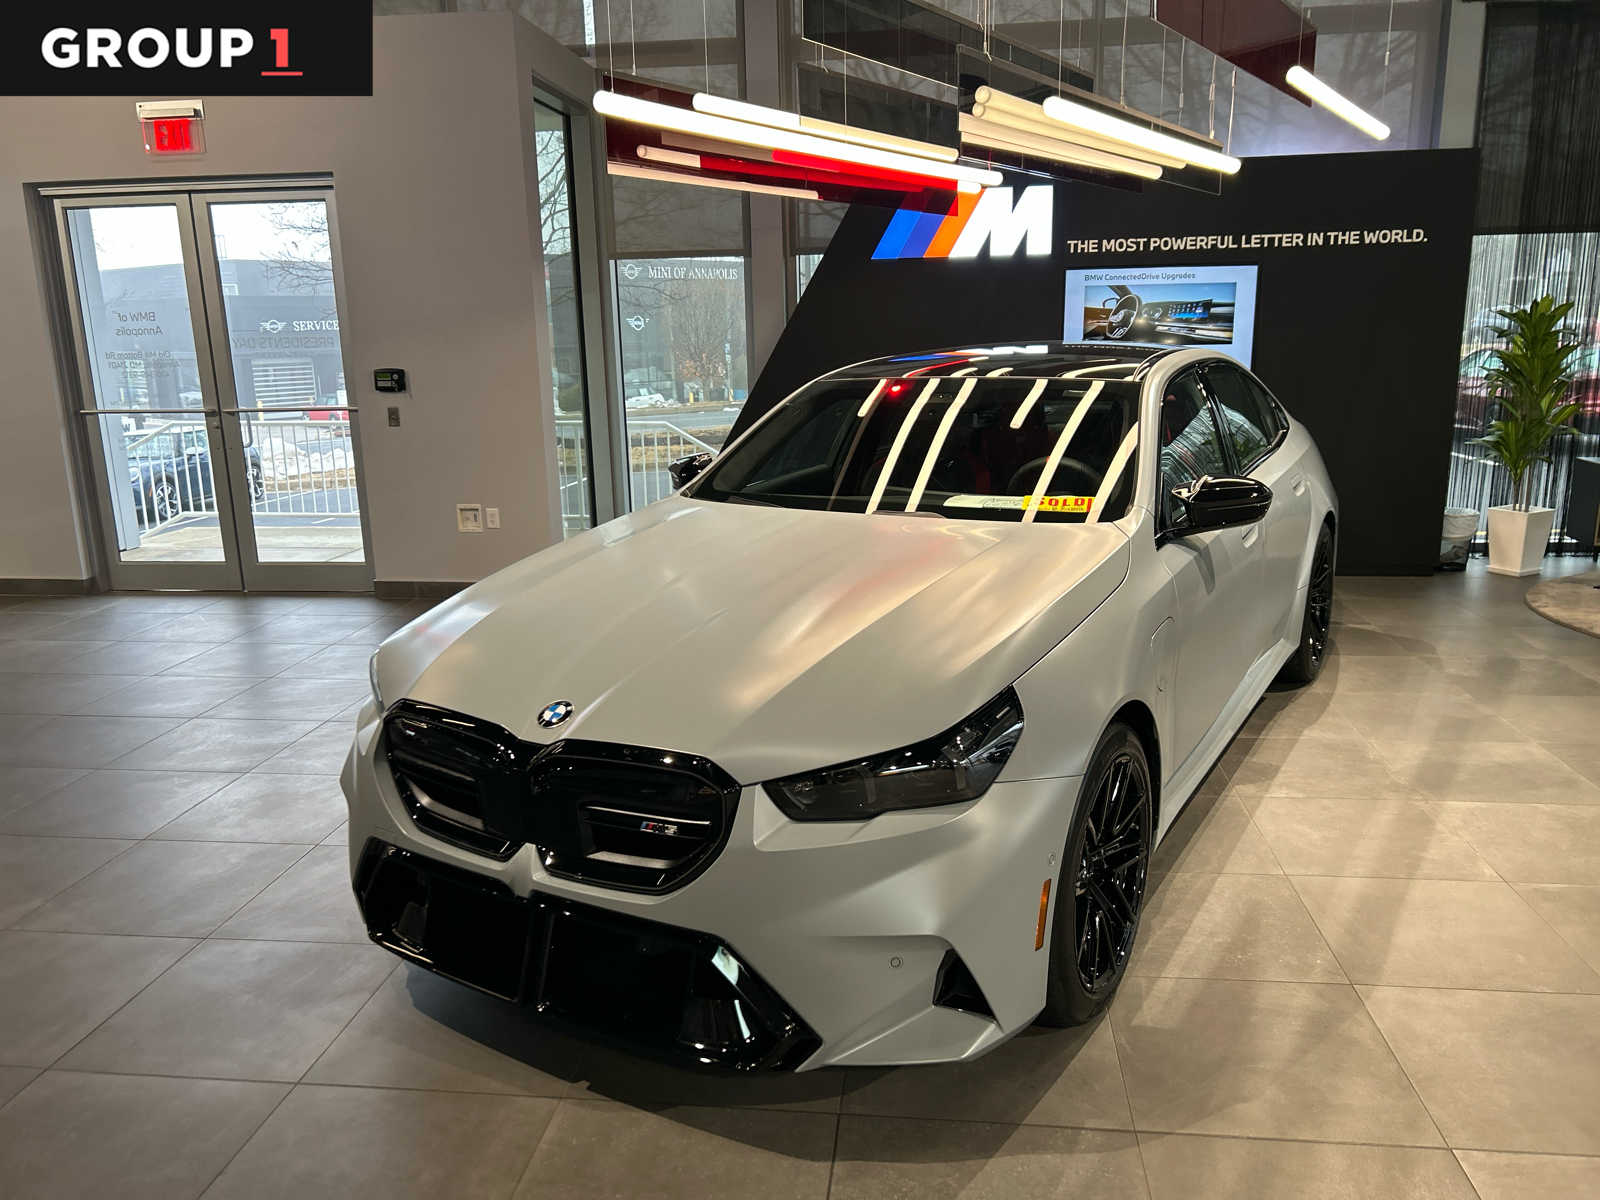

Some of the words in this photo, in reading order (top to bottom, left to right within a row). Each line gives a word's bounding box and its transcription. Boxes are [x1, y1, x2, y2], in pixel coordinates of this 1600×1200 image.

[947, 185, 1053, 257] M
[1067, 239, 1098, 253] THE
[1102, 238, 1147, 253] MOST
[1150, 235, 1238, 251] POWERFUL
[1241, 232, 1303, 248] LETTER
[1307, 232, 1324, 246] IN
[1327, 230, 1360, 245] THE
[1364, 228, 1428, 244] WORLD.
[648, 266, 671, 279] MINI
[673, 267, 687, 279] OF
[689, 267, 738, 279] ANNAPOLIS
[1104, 273, 1160, 281] ConnectedDrive
[1161, 272, 1196, 281] Upgrades
[292, 320, 340, 331] SERVICE
